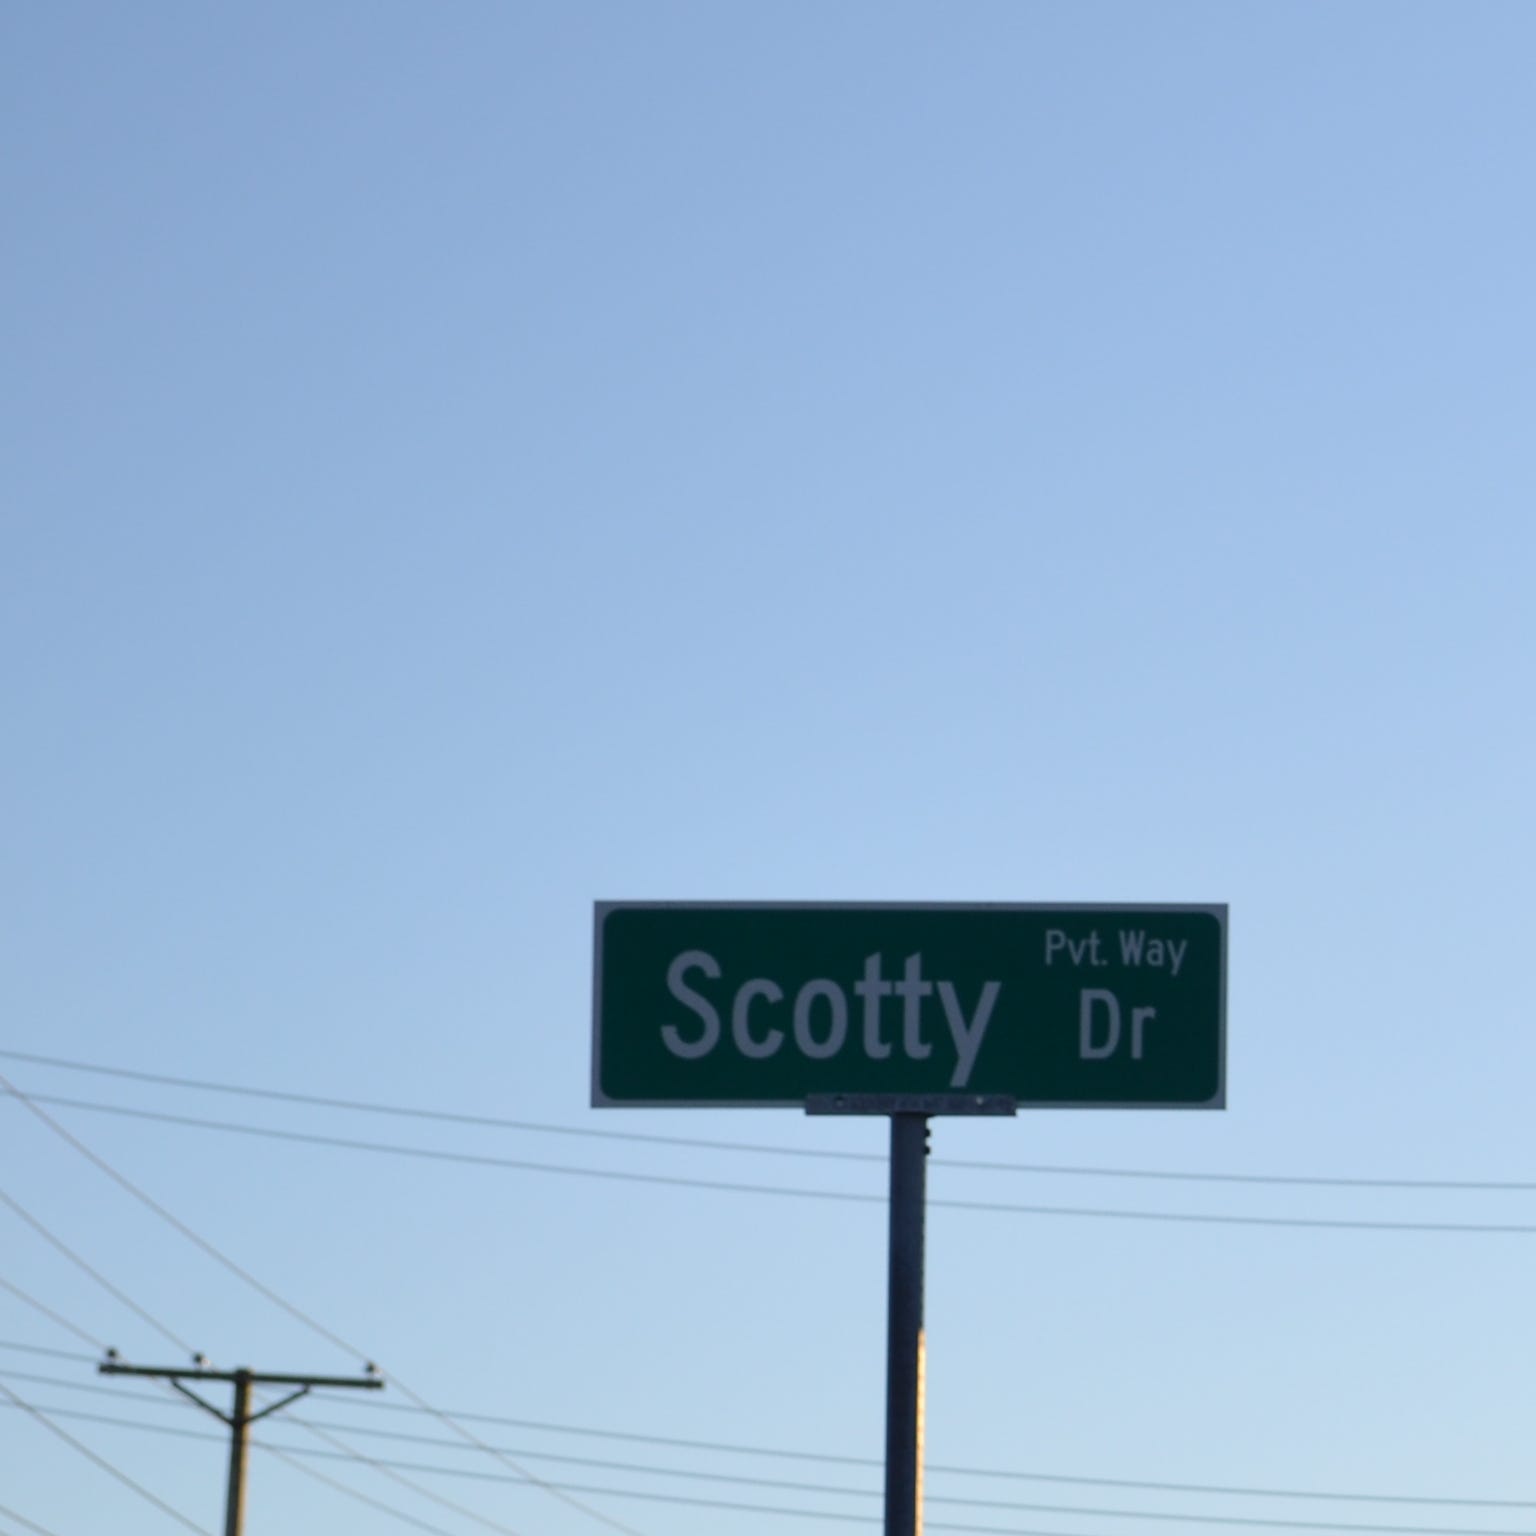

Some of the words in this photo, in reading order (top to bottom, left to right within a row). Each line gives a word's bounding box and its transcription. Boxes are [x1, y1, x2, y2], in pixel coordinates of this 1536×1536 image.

[1044, 928, 1109, 967] Pvt.
[1118, 929, 1188, 976] Way
[660, 948, 1002, 1088] Scotty
[1078, 987, 1157, 1060] Dr
